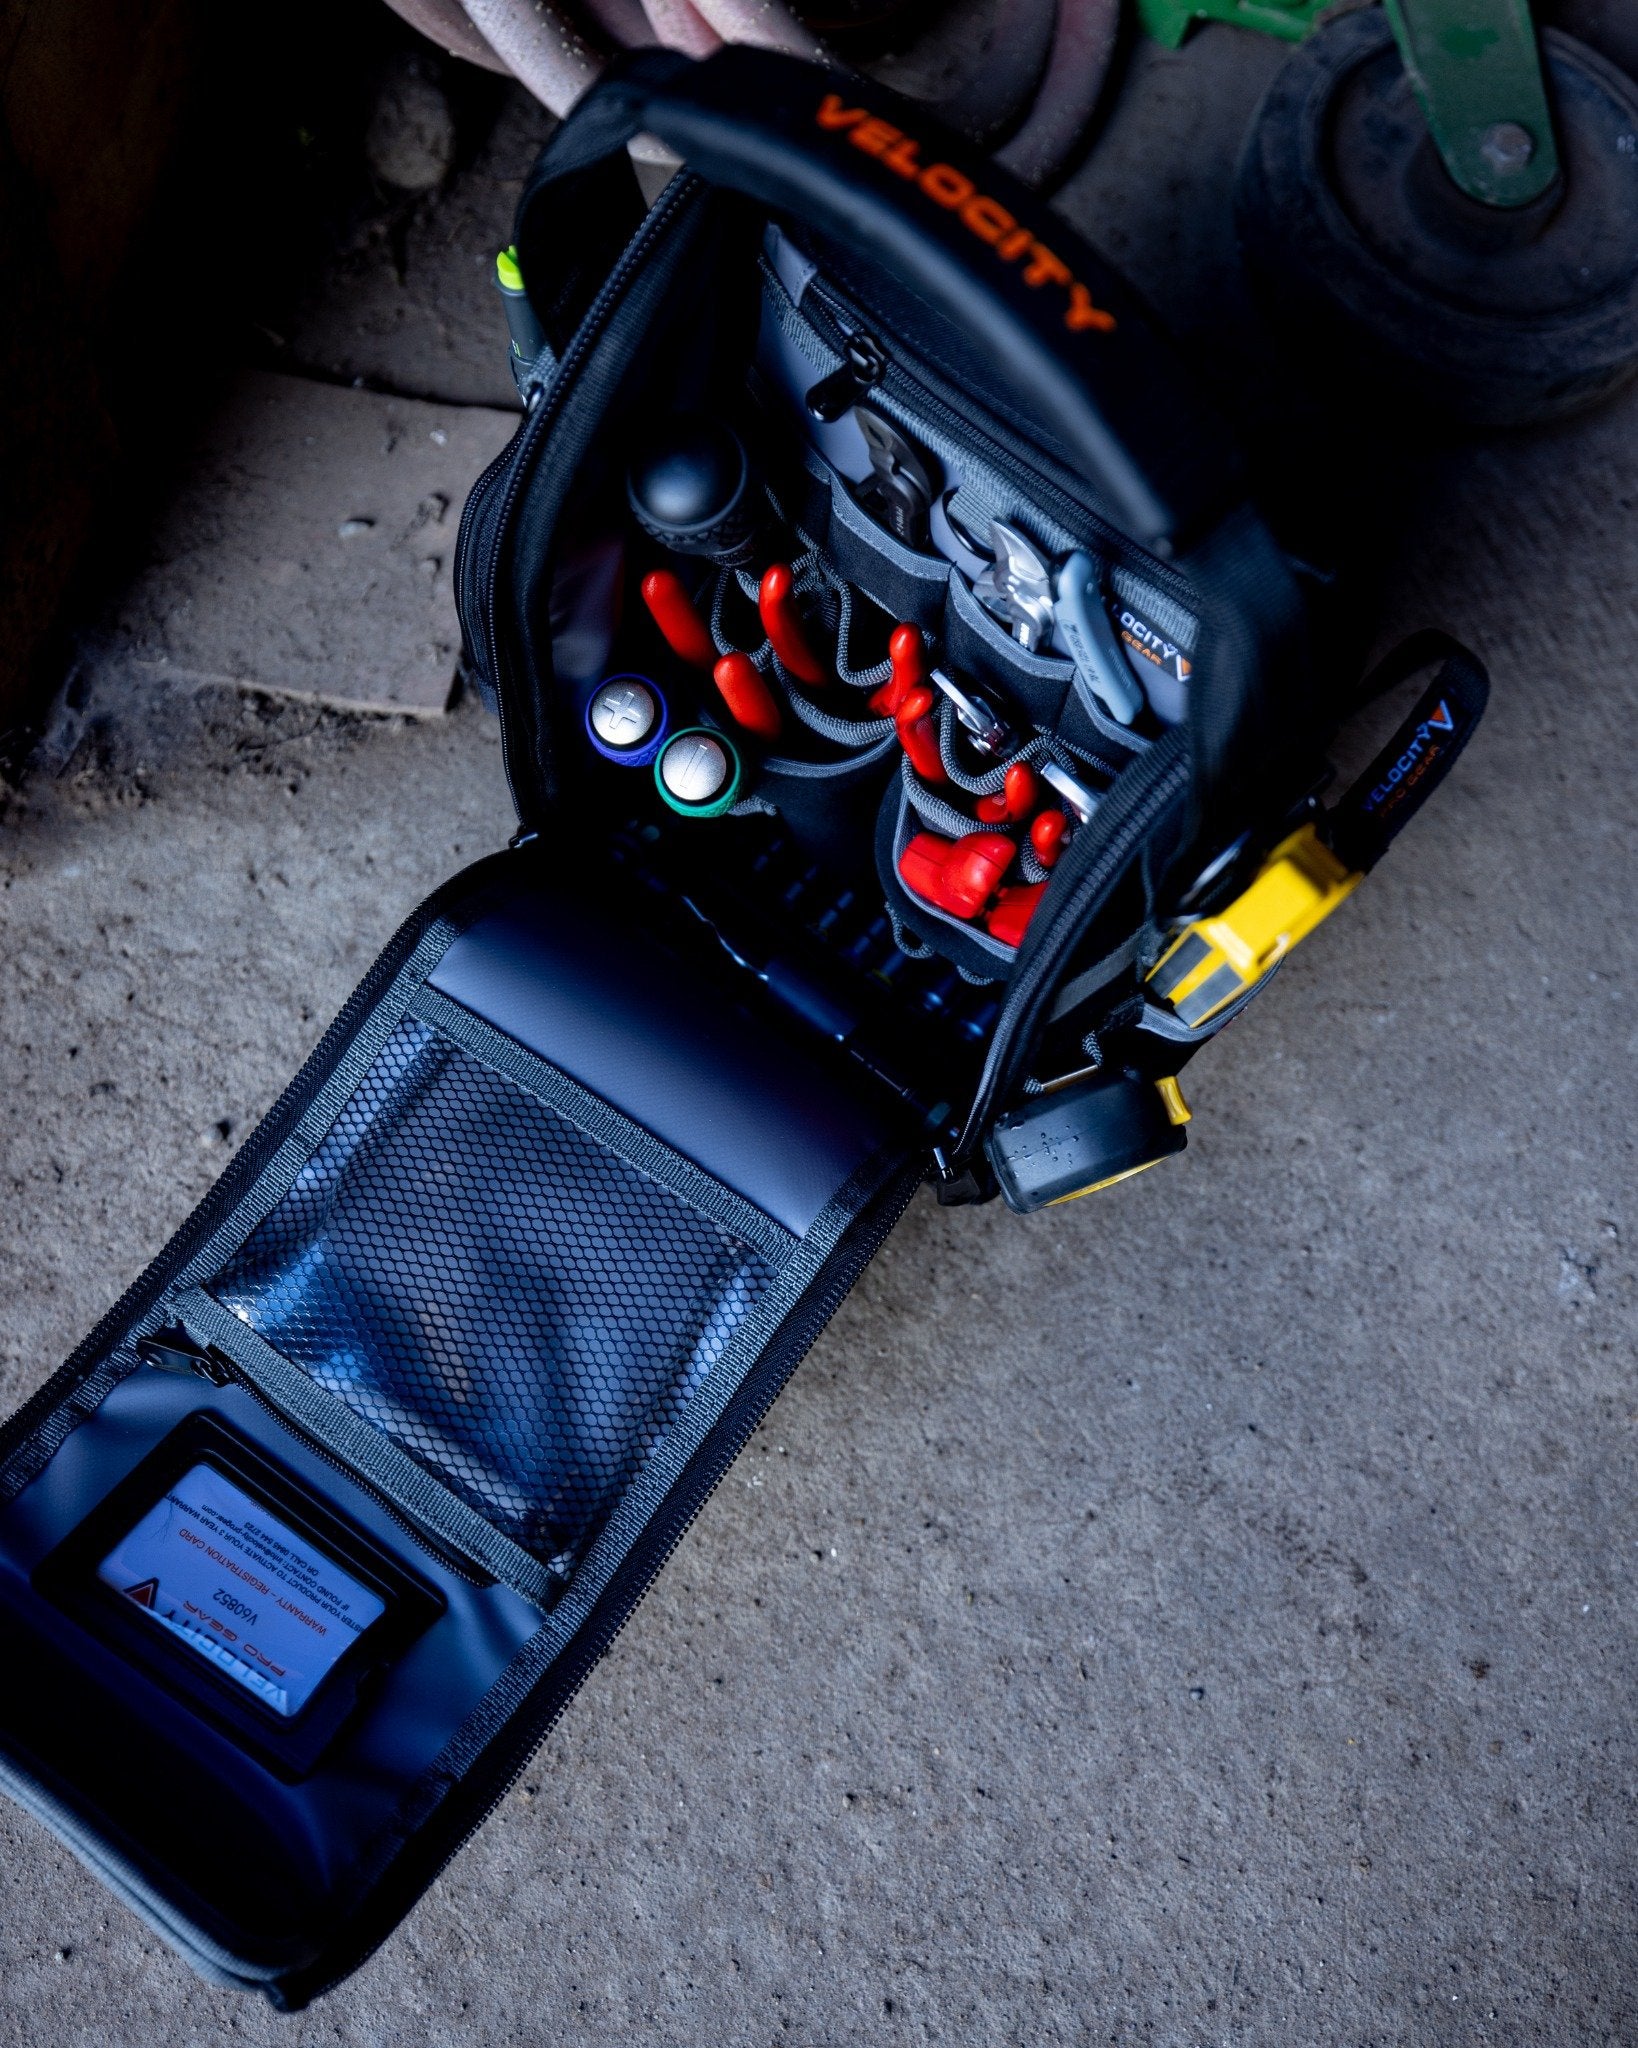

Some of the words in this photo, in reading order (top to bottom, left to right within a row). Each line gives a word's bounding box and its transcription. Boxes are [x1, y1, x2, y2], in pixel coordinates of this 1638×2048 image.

[817, 94, 1116, 332] VELOCITY
[1359, 722, 1434, 814] VELOCITY
[198, 1515, 219, 1532] YEAR
[217, 1528, 225, 1536] 3
[178, 1527, 206, 1550] CARD
[223, 1532, 245, 1550] YOUR
[204, 1545, 269, 1595] REGISTRATION
[243, 1545, 277, 1573] ACTIVATE
[288, 1552, 307, 1569] CALL
[306, 1564, 319, 1576] OR
[275, 1569, 288, 1580] TO
[281, 1559, 317, 1588] CONTACT:
[287, 1577, 321, 1604] PRODUCT
[315, 1584, 342, 1606] FOUND
[211, 1586, 260, 1626] V60852
[275, 1595, 327, 1636] WARRANTY
[319, 1600, 341, 1618] YOUR
[340, 1601, 349, 1611] IF
[182, 1599, 237, 1642] GEAR
[159, 1605, 287, 1702] VELOCITY
[241, 1642, 285, 1677] PRO
